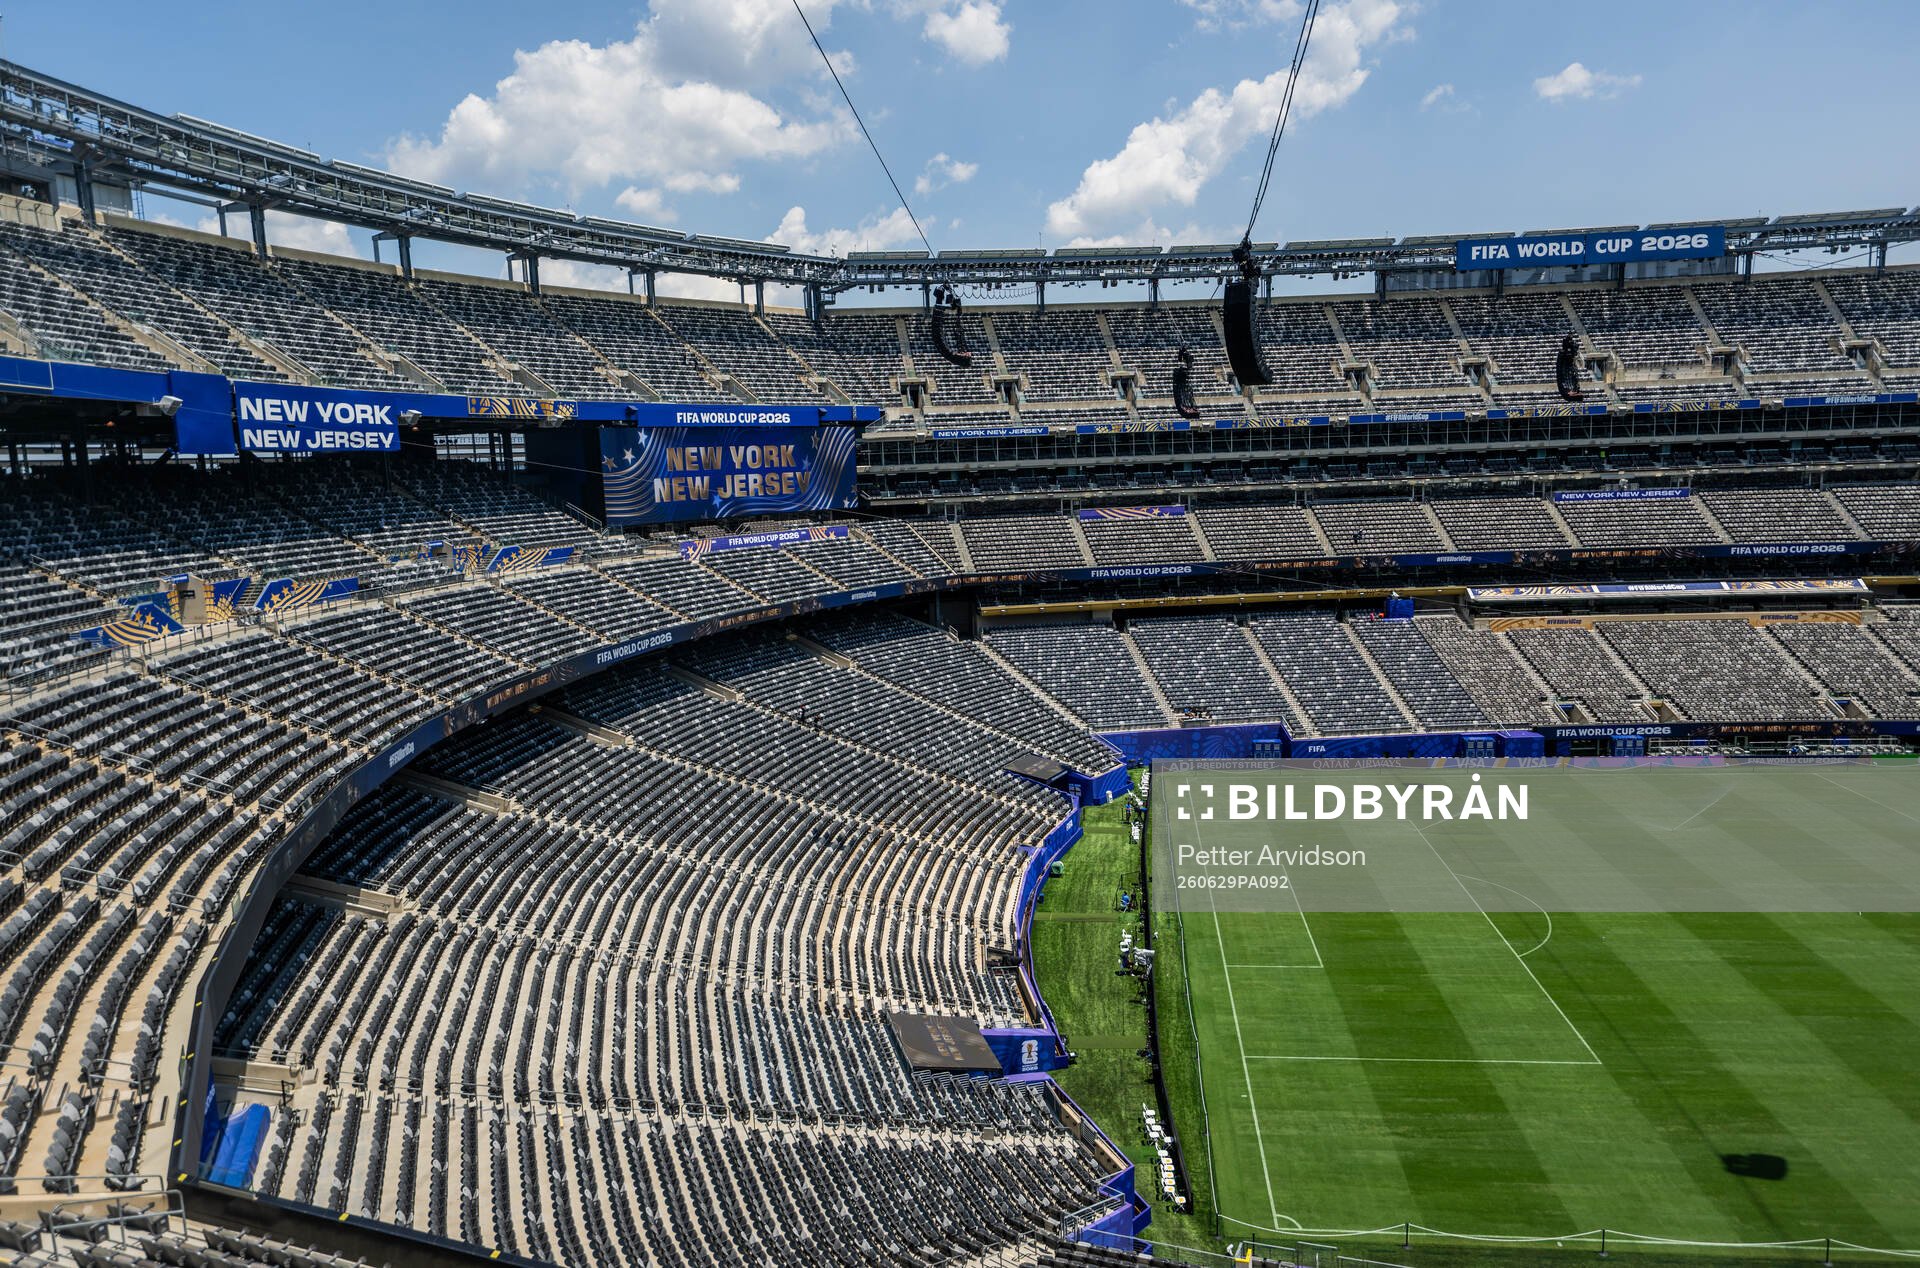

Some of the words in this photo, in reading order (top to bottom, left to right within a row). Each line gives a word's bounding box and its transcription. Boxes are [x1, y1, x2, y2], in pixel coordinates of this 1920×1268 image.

[1472, 245, 1510, 260] FIFA
[1517, 241, 1584, 258] WORLD
[1595, 239, 1633, 254] CUP
[1641, 234, 1709, 251] 2026
[239, 397, 309, 423] NEW
[315, 402, 394, 425] YORK
[676, 412, 699, 424] FIFA
[700, 412, 737, 424] WORLD
[738, 413, 757, 424] CUP
[758, 413, 791, 424] 2026
[243, 429, 301, 448] NEW
[306, 431, 394, 449] JERSEY
[666, 446, 723, 472] NEW
[729, 444, 797, 470] YORK
[653, 475, 710, 503] NEW
[717, 471, 811, 499] JERSEY
[728, 537, 743, 546] FIFA
[743, 535, 766, 545] WORLD
[766, 534, 779, 542] CUP
[779, 532, 800, 541] 2026
[1731, 547, 1752, 555] FIFA
[1753, 546, 1788, 554] WORLD
[1789, 545, 1809, 553] CUP
[1810, 544, 1846, 553] 2026
[1110, 568, 1142, 576] WORLD
[1143, 567, 1161, 575] CUP
[1161, 566, 1192, 574] 2026
[597, 653, 613, 665] FIFA
[613, 644, 637, 659] WORLD
[637, 639, 650, 651] CUP
[650, 632, 673, 647] 2026
[1556, 728, 1577, 737] FIFA
[1578, 727, 1614, 736] WORLD
[1615, 727, 1635, 735] CUP
[1636, 726, 1672, 735] 2026
[1312, 760, 1350, 769] QATAR
[1456, 757, 1485, 768] VISA
[1517, 757, 1547, 768] VISA
